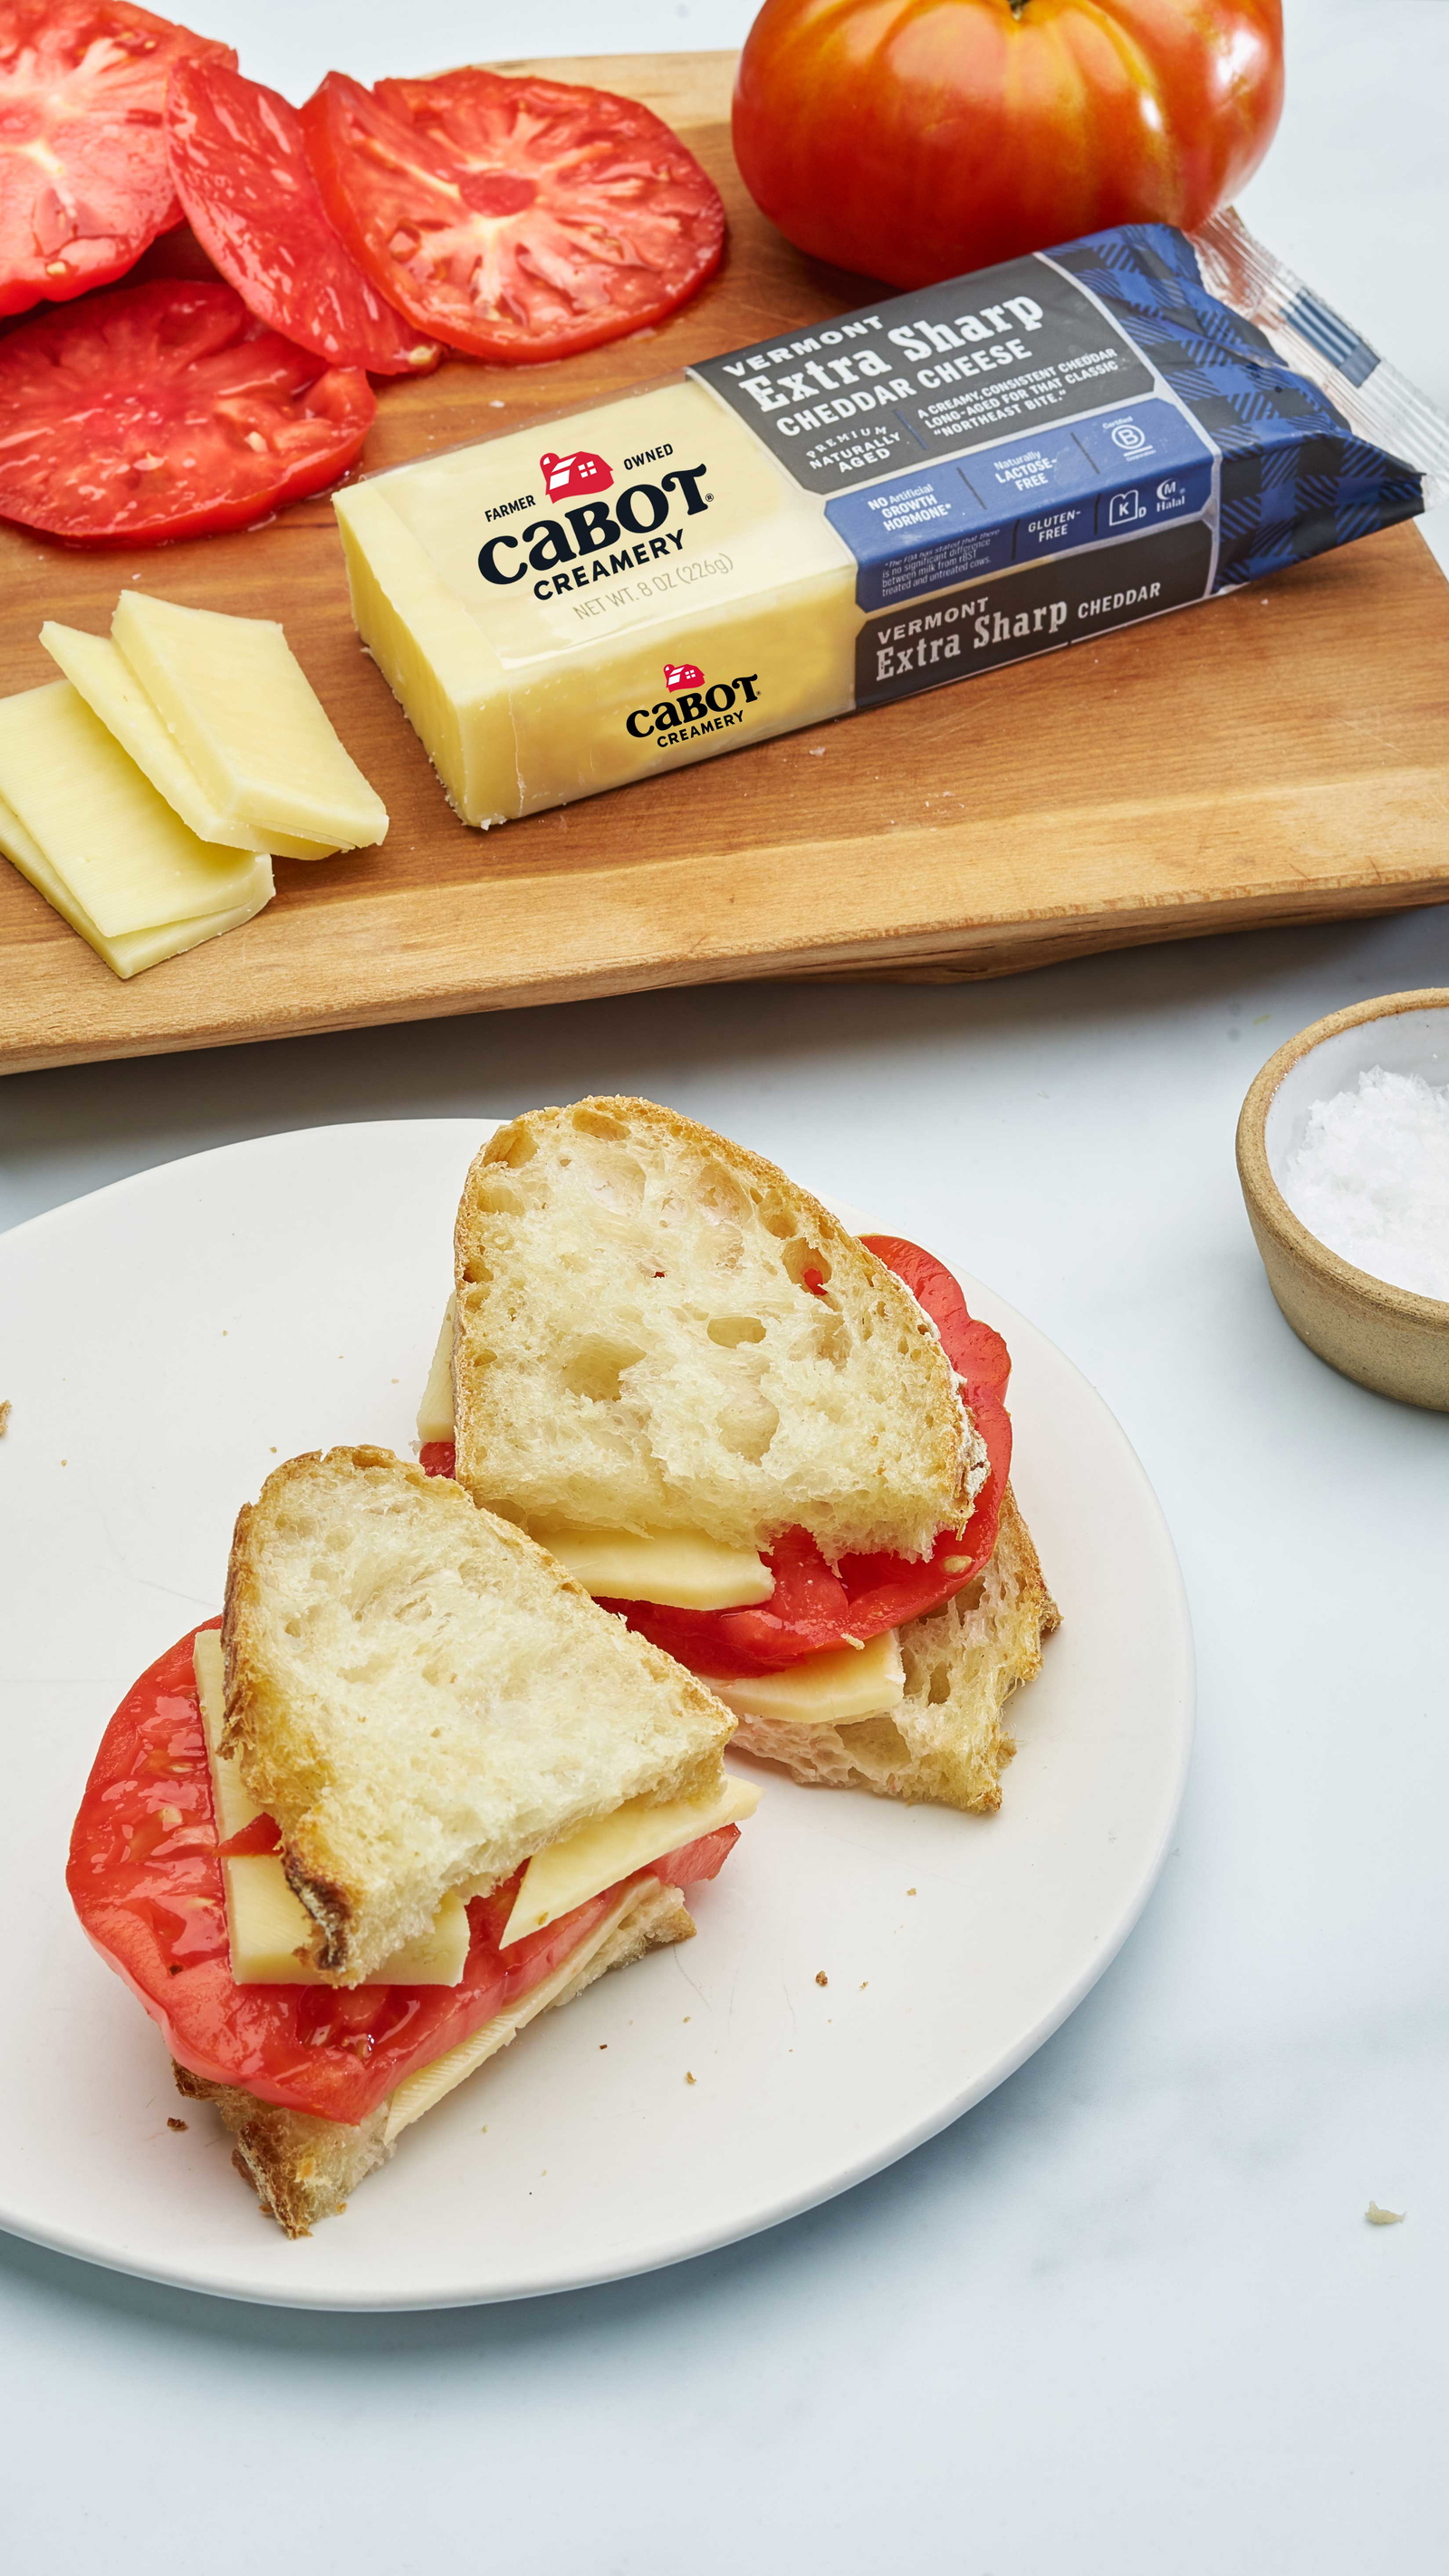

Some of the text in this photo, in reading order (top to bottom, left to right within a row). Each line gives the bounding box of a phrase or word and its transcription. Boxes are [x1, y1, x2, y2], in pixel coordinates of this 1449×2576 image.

[722, 315, 884, 377] VERMONT
[738, 295, 1043, 413] Extra Sharp
[776, 338, 1032, 437] CHEDDAR CHEESE
[917, 348, 1118, 419] A CREAMY, CONSISTENT CHEDDAR
[925, 360, 1118, 429] LONG-AGED FOR THAT CLASSIC
[806, 427, 887, 458] PREMIUM
[809, 432, 900, 469] NATURALLY
[839, 447, 890, 473] AGED
[993, 450, 1041, 471] Naturally
[995, 457, 1057, 484] LACTOSE-
[485, 443, 674, 523] FARMER OWNED
[867, 484, 934, 511] NO Artificial
[1014, 473, 1049, 491] FREE
[1164, 481, 1176, 495] M
[881, 495, 937, 519] GROWTH
[1119, 502, 1129, 516] K
[1138, 506, 1147, 518] D
[1156, 495, 1185, 513] Halal
[1028, 510, 1081, 533] GLUTEN-
[1039, 524, 1068, 543] FREE
[533, 528, 684, 601] CREAMERY
[572, 553, 734, 620] NET WT. 8 OZ (226g)
[876, 582, 1161, 681] Extra Sharp CHEDDAR
[877, 597, 989, 645] VERMONT
[657, 710, 744, 748] CREAMERY
